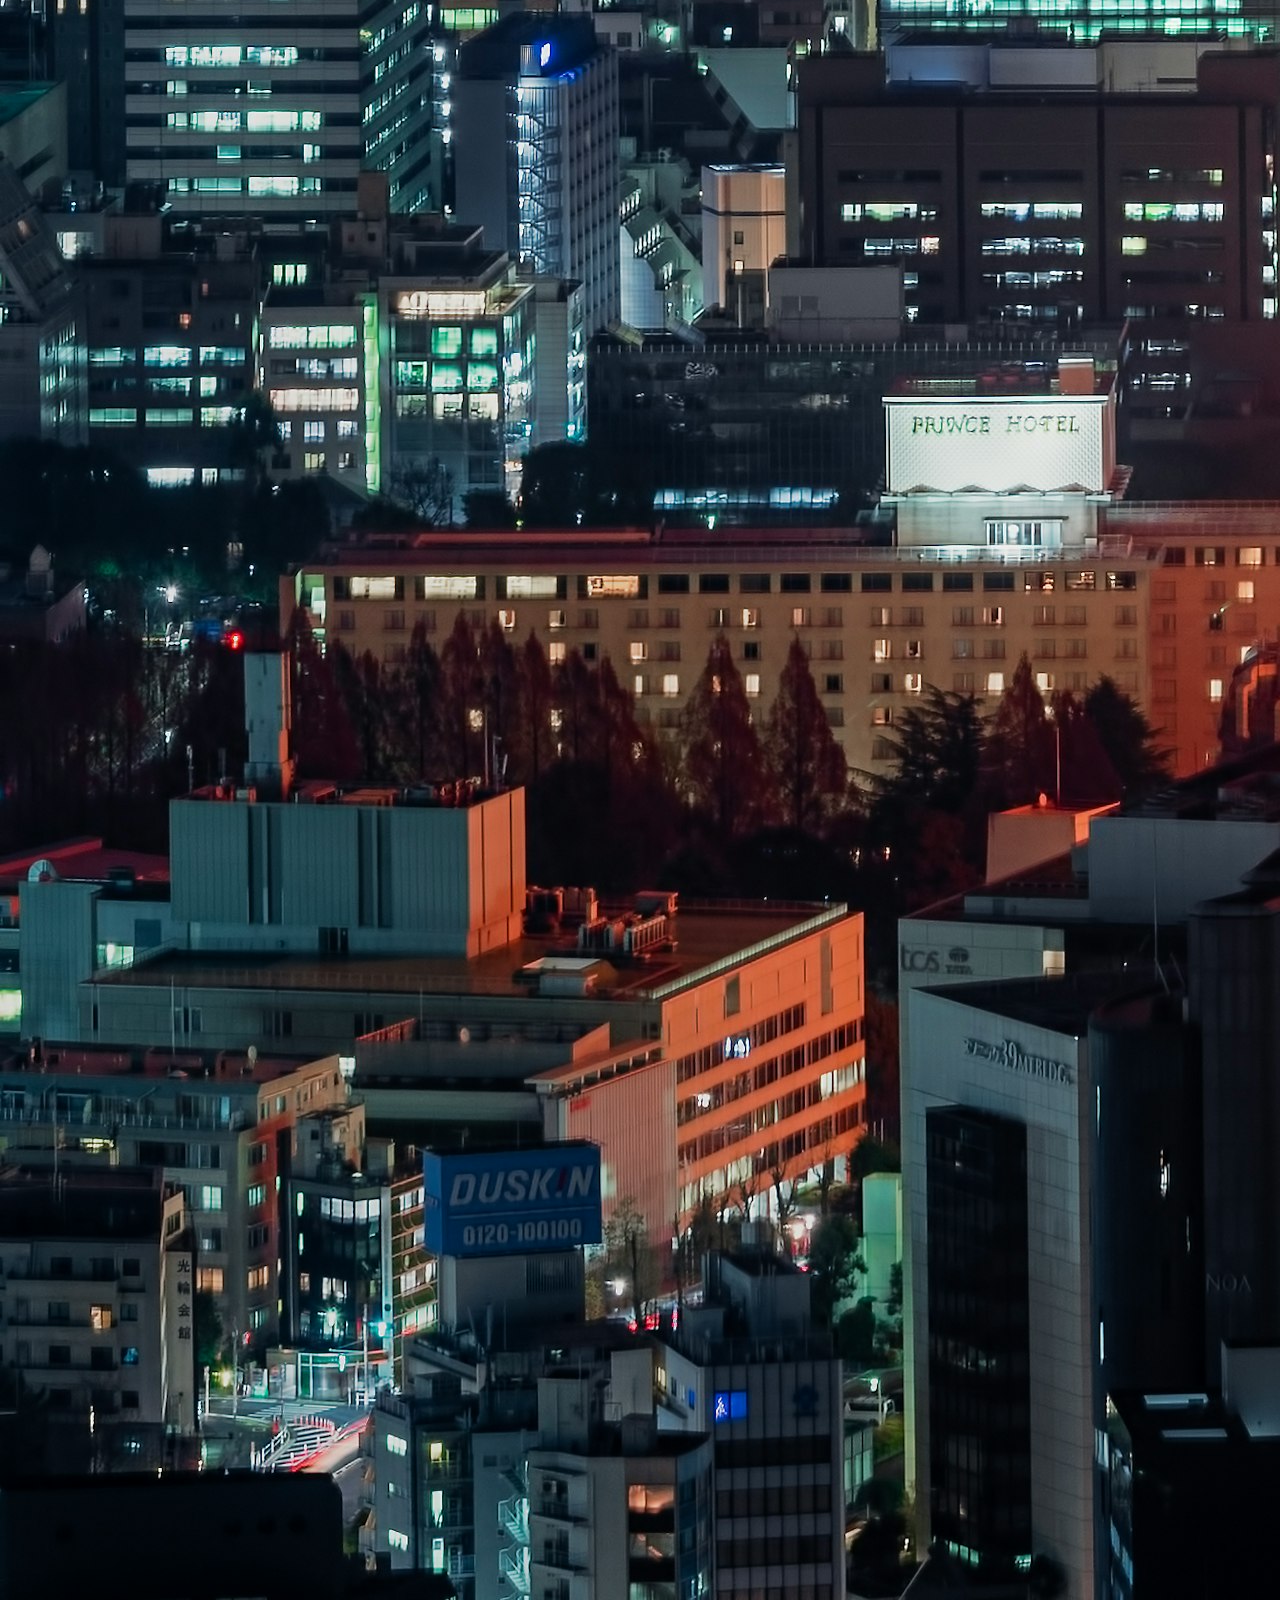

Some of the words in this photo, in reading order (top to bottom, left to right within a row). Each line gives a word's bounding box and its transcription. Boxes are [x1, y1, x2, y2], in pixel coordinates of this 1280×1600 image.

[912, 414, 991, 434] PRINCE
[1006, 415, 1080, 433] HOTEL
[463, 1218, 582, 1247] 0120-100100
[1206, 1272, 1253, 1294] NOA
